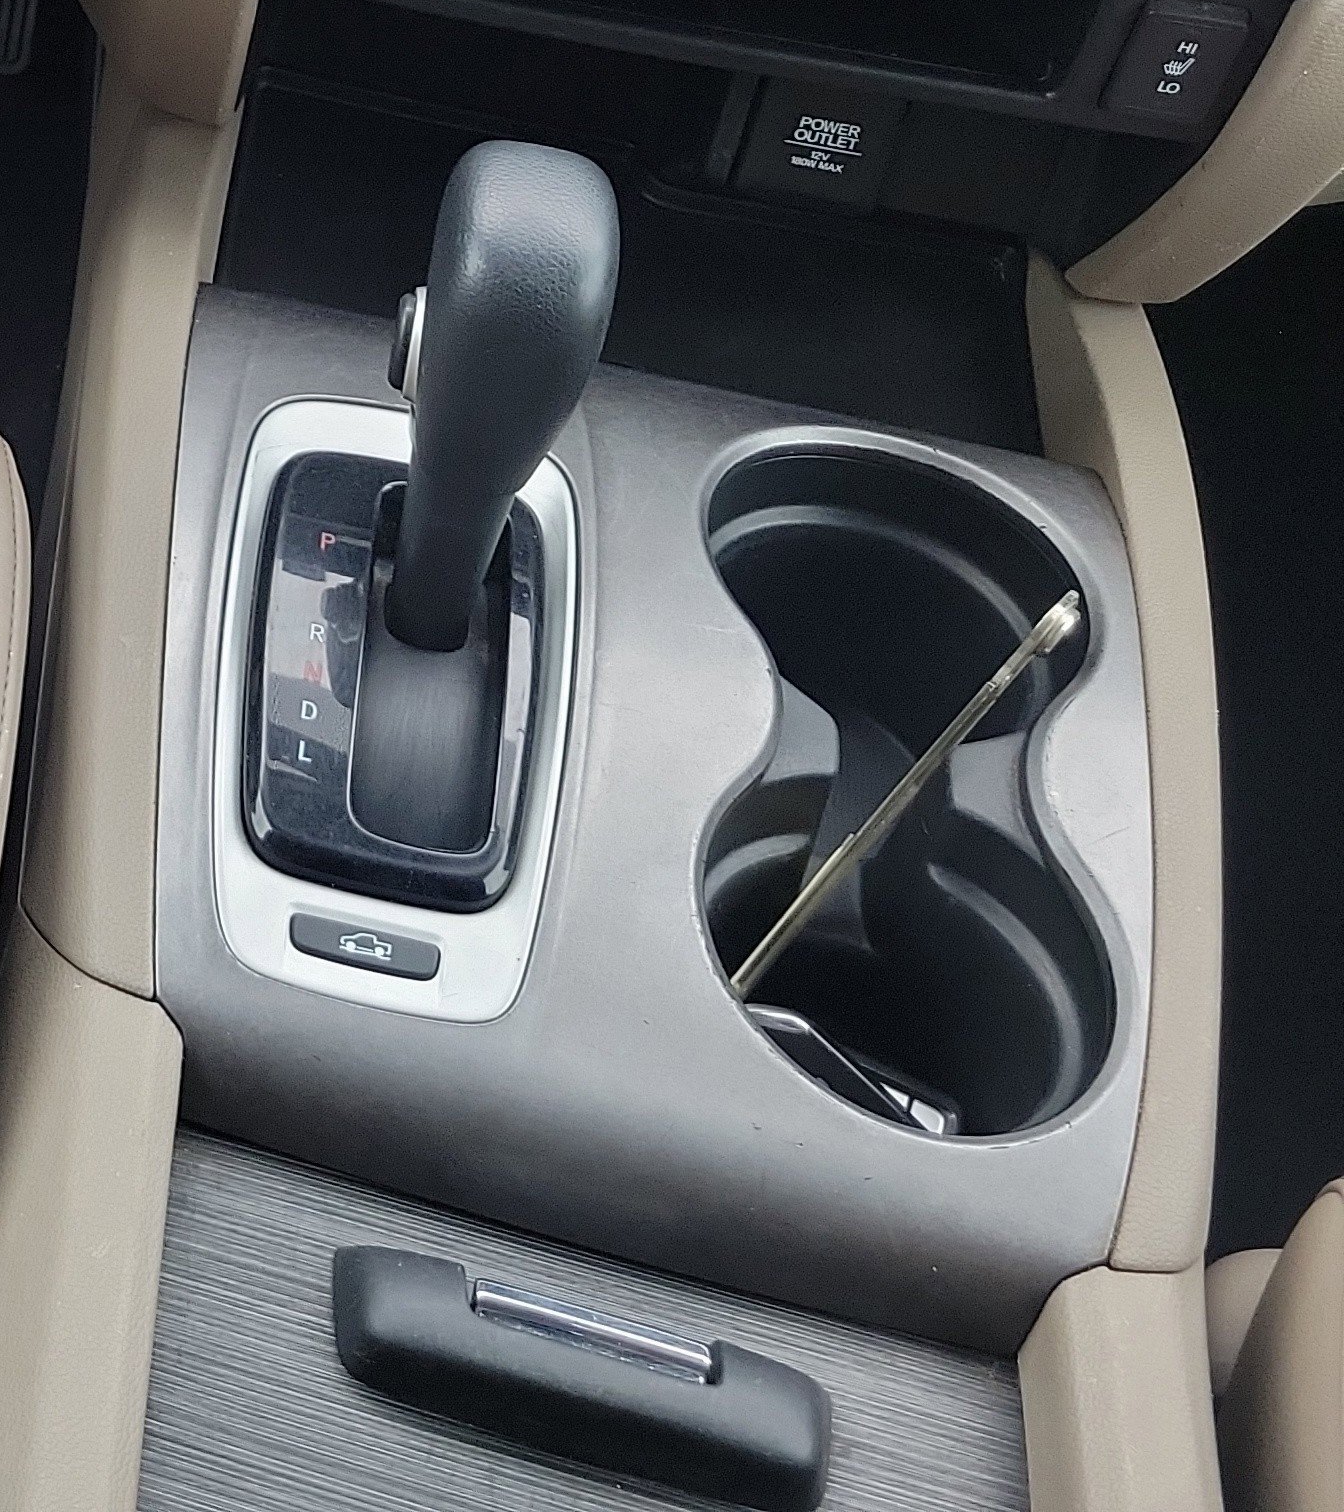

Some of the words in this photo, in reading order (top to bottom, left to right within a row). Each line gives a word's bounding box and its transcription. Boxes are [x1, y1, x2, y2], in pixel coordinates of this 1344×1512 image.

[1177, 41, 1199, 55] HI
[1157, 80, 1181, 94] LO
[799, 116, 861, 139] POWER
[793, 128, 861, 150] OUTLET
[810, 150, 831, 162] 12V
[818, 161, 845, 175] MAX
[320, 531, 336, 551] P
[310, 622, 325, 643] R
[301, 699, 318, 720] D
[297, 739, 312, 763] L
